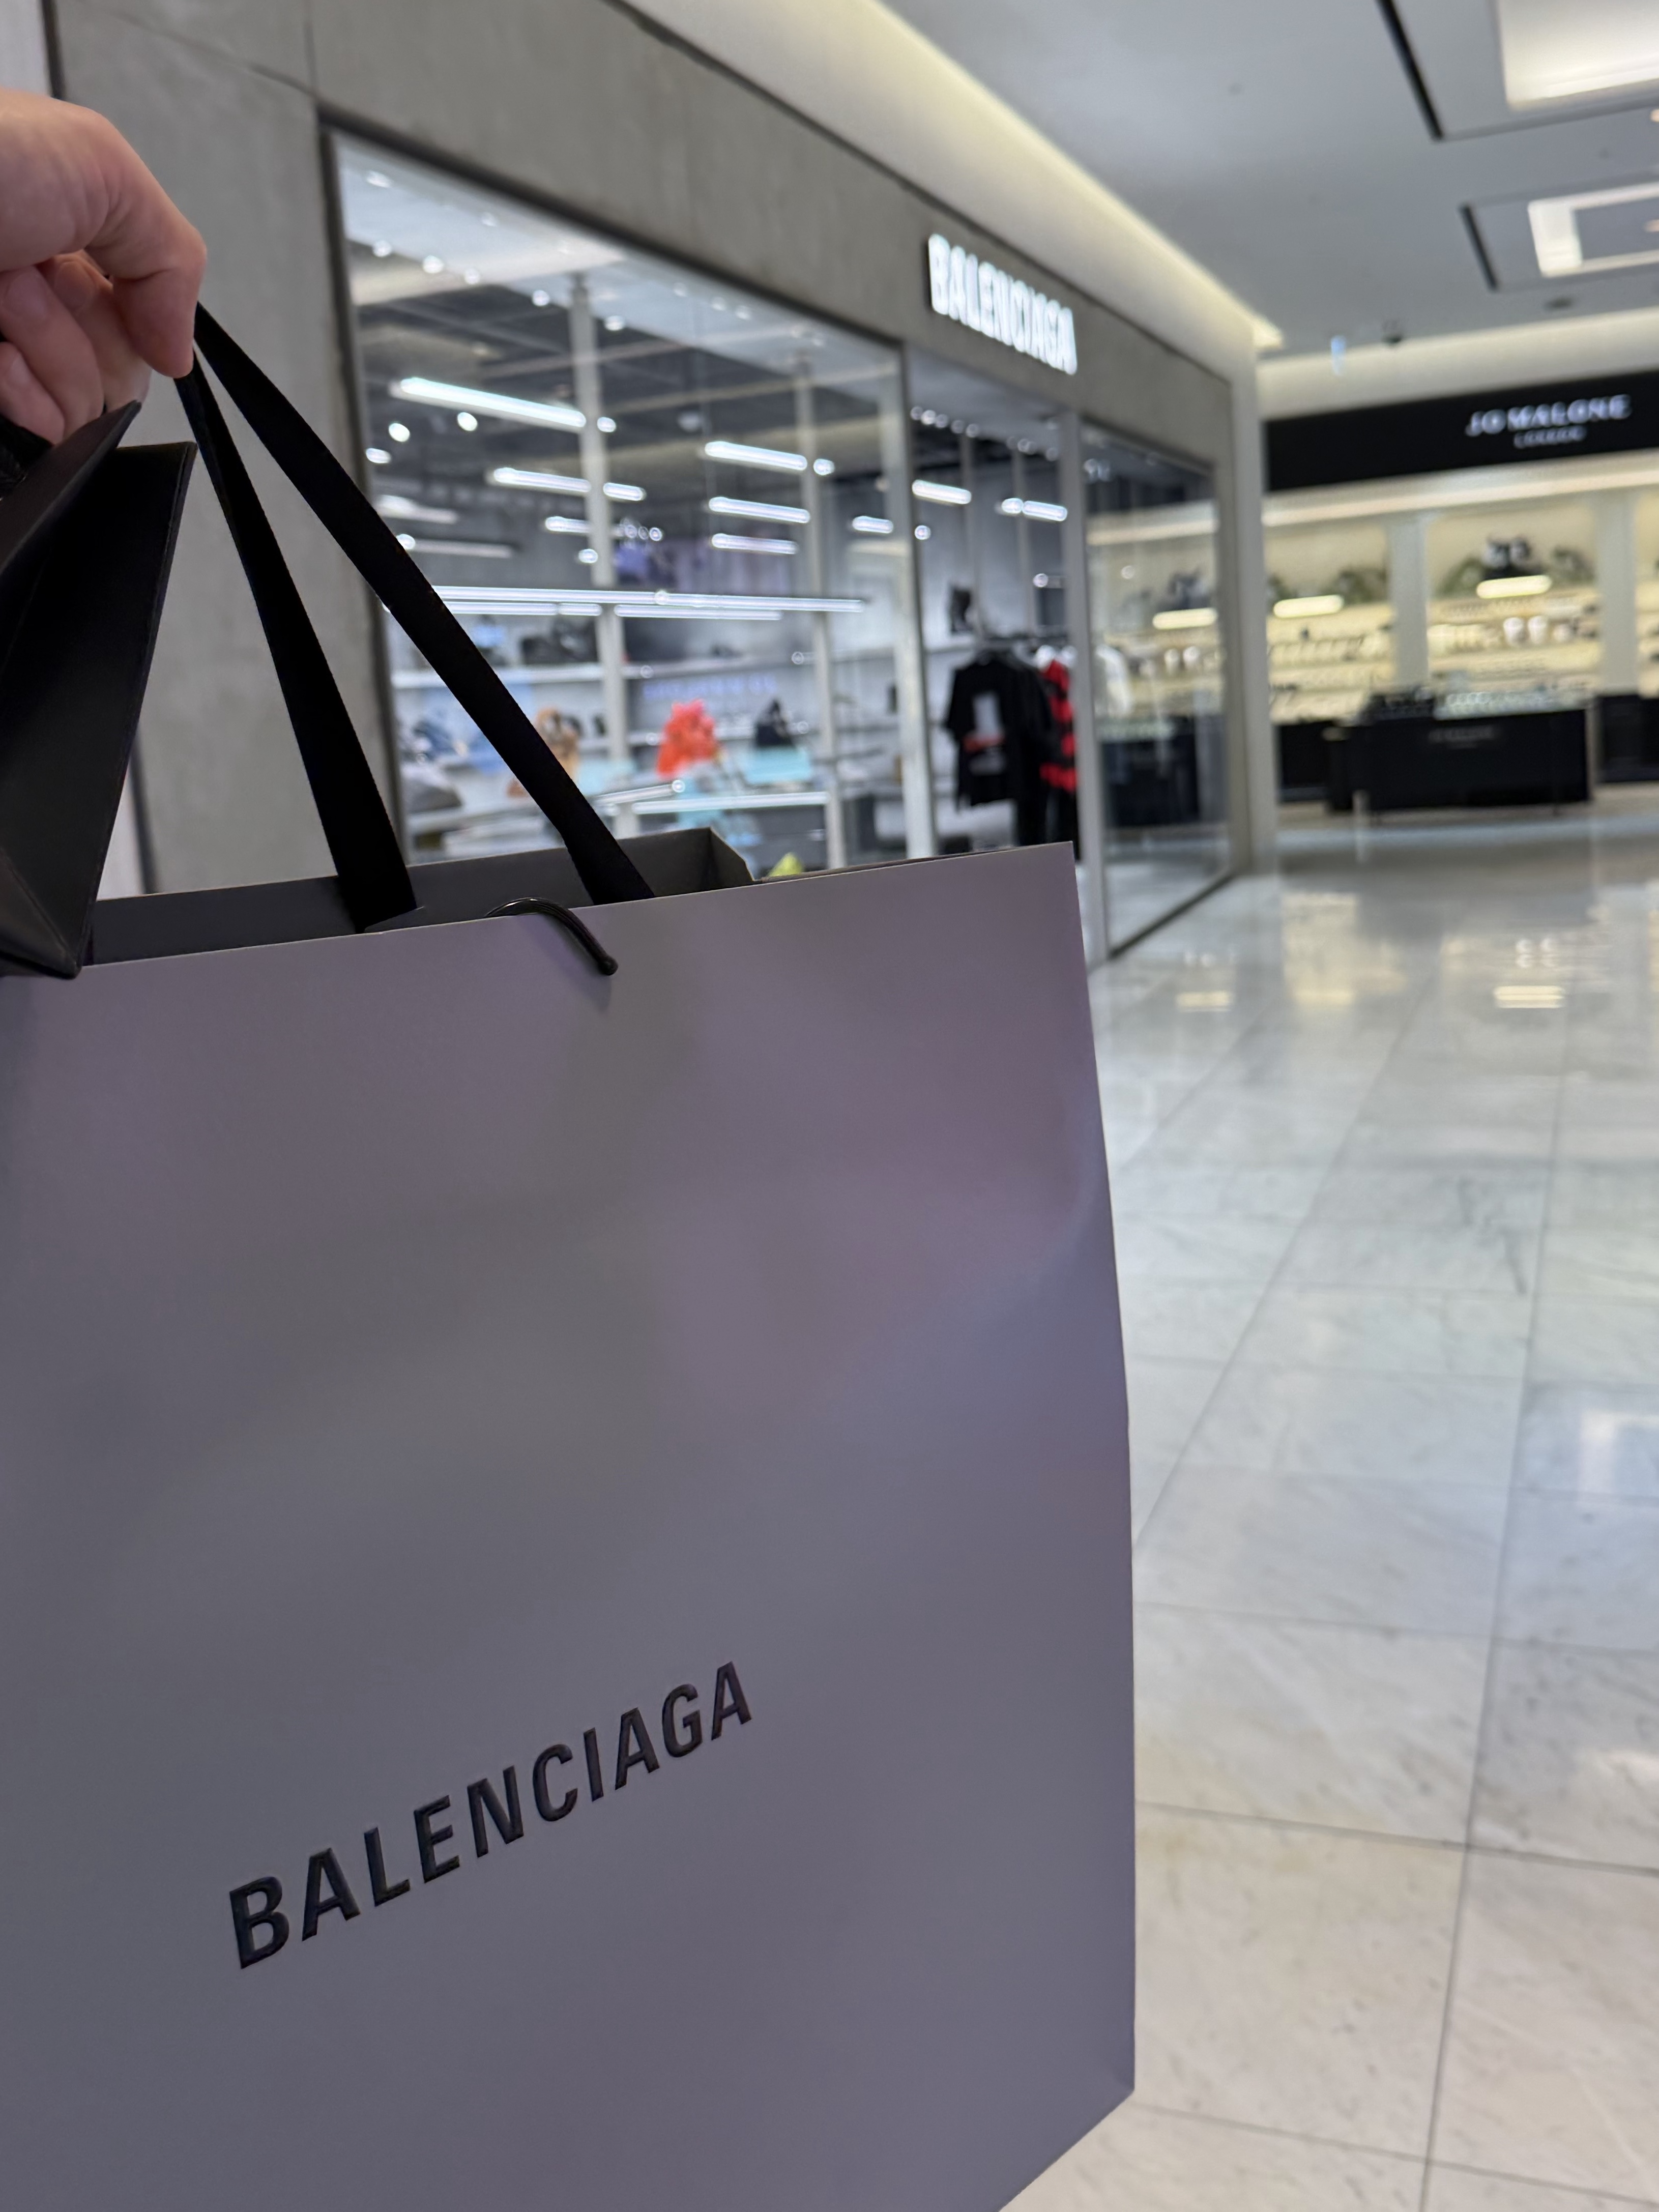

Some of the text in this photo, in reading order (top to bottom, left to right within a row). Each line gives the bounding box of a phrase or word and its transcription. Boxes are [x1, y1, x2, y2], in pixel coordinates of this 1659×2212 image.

[928, 234, 1078, 375] BALENCIAGA
[1465, 394, 1631, 436] JO MALONE
[229, 1661, 752, 1970] BALENCIAGA
